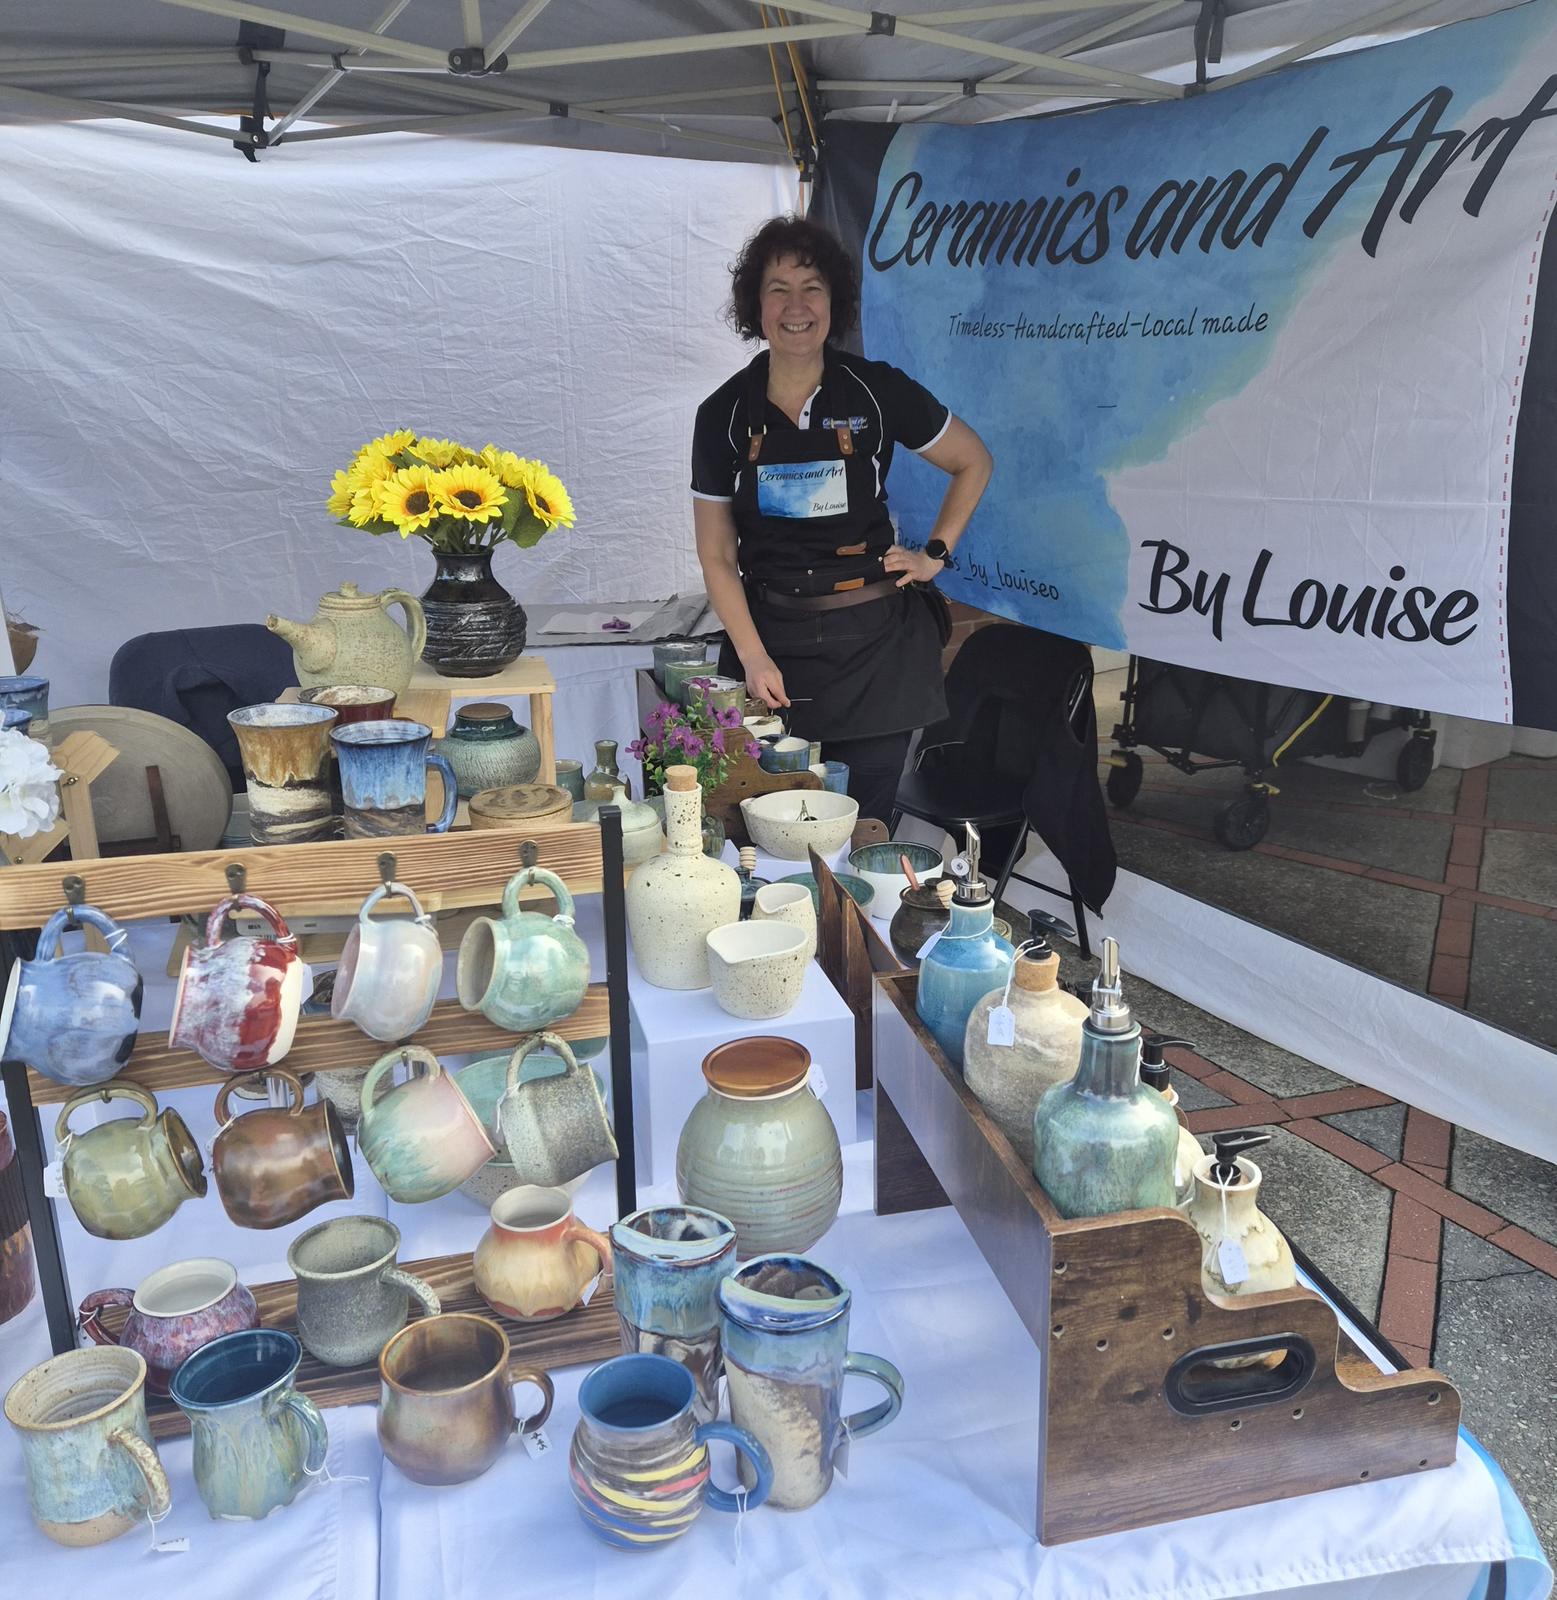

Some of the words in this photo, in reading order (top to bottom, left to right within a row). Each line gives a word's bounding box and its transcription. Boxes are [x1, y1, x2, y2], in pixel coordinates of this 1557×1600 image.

[869, 167, 1127, 271] Ceramics
[1125, 126, 1330, 259] and
[1303, 74, 1557, 258] Art
[949, 307, 1198, 344] Timeless-Handcrafted-Local
[1201, 302, 1268, 334] made
[759, 470, 803, 482] Ceramics
[804, 468, 825, 479] and
[825, 466, 844, 478] Art
[813, 502, 824, 512] By
[897, 527, 1059, 600] cers_by_louiseo
[1138, 539, 1231, 642] By
[1242, 548, 1480, 646] Louise
